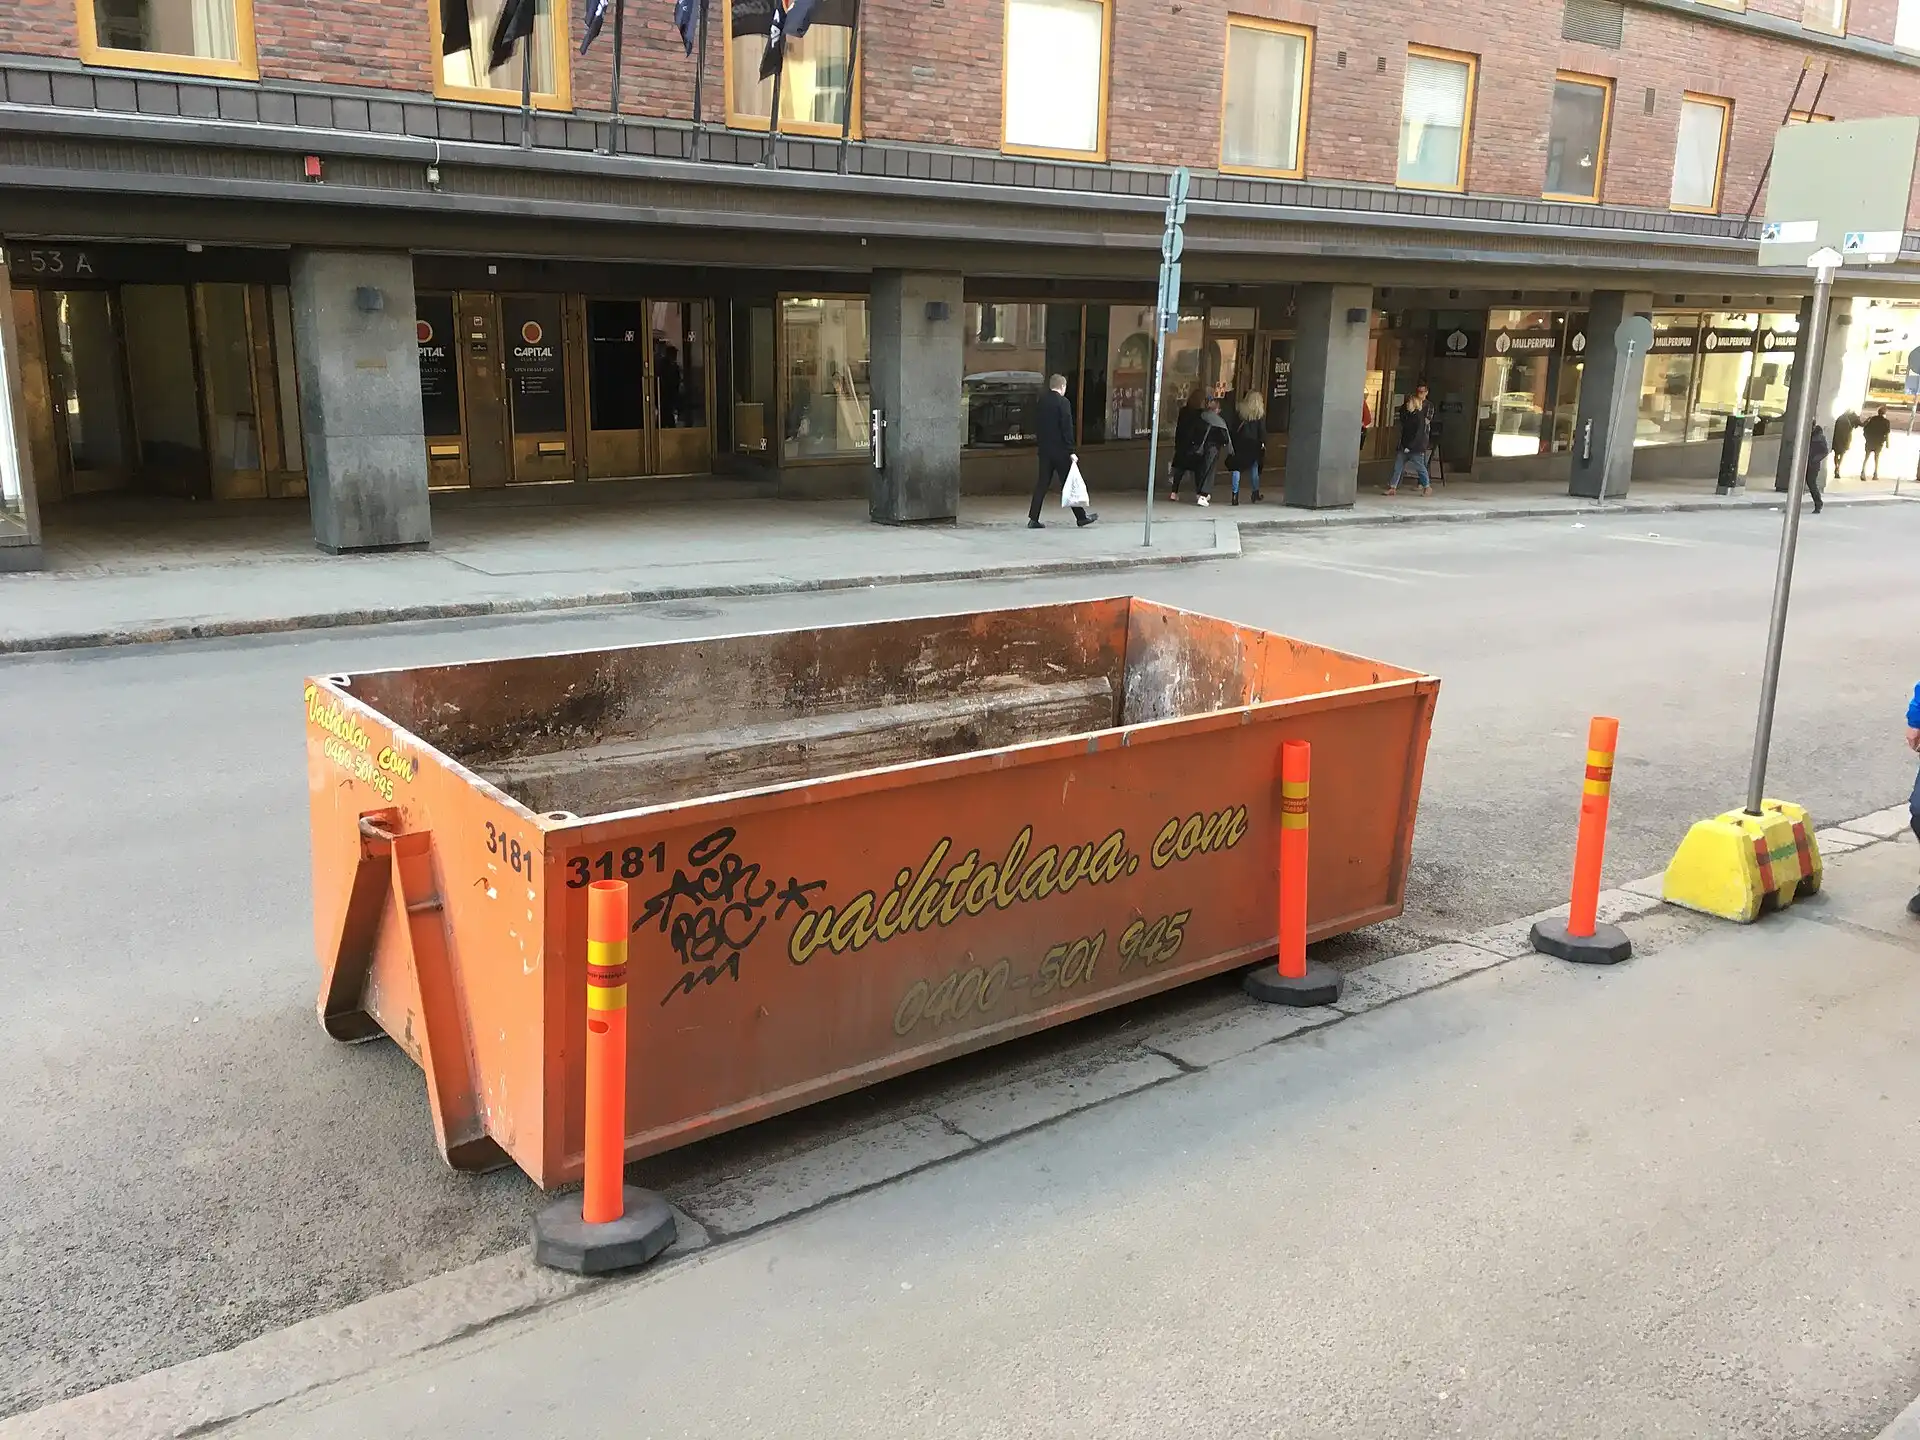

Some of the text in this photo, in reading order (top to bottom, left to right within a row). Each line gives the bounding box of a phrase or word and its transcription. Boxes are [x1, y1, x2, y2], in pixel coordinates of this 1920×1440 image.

[76, 253, 92, 272] A
[1511, 338, 1555, 348] MULPERIPUU
[1655, 337, 1692, 347] MULPERIPUU
[1717, 336, 1751, 346] MULPERIPUU
[418, 347, 445, 357] PITAL
[514, 347, 552, 357] CAPITAL
[1275, 362, 1290, 373] BLOCK
[485, 821, 532, 882] 3181
[566, 841, 666, 889] 3181
[893, 906, 1193, 1037] 0400-501 945
